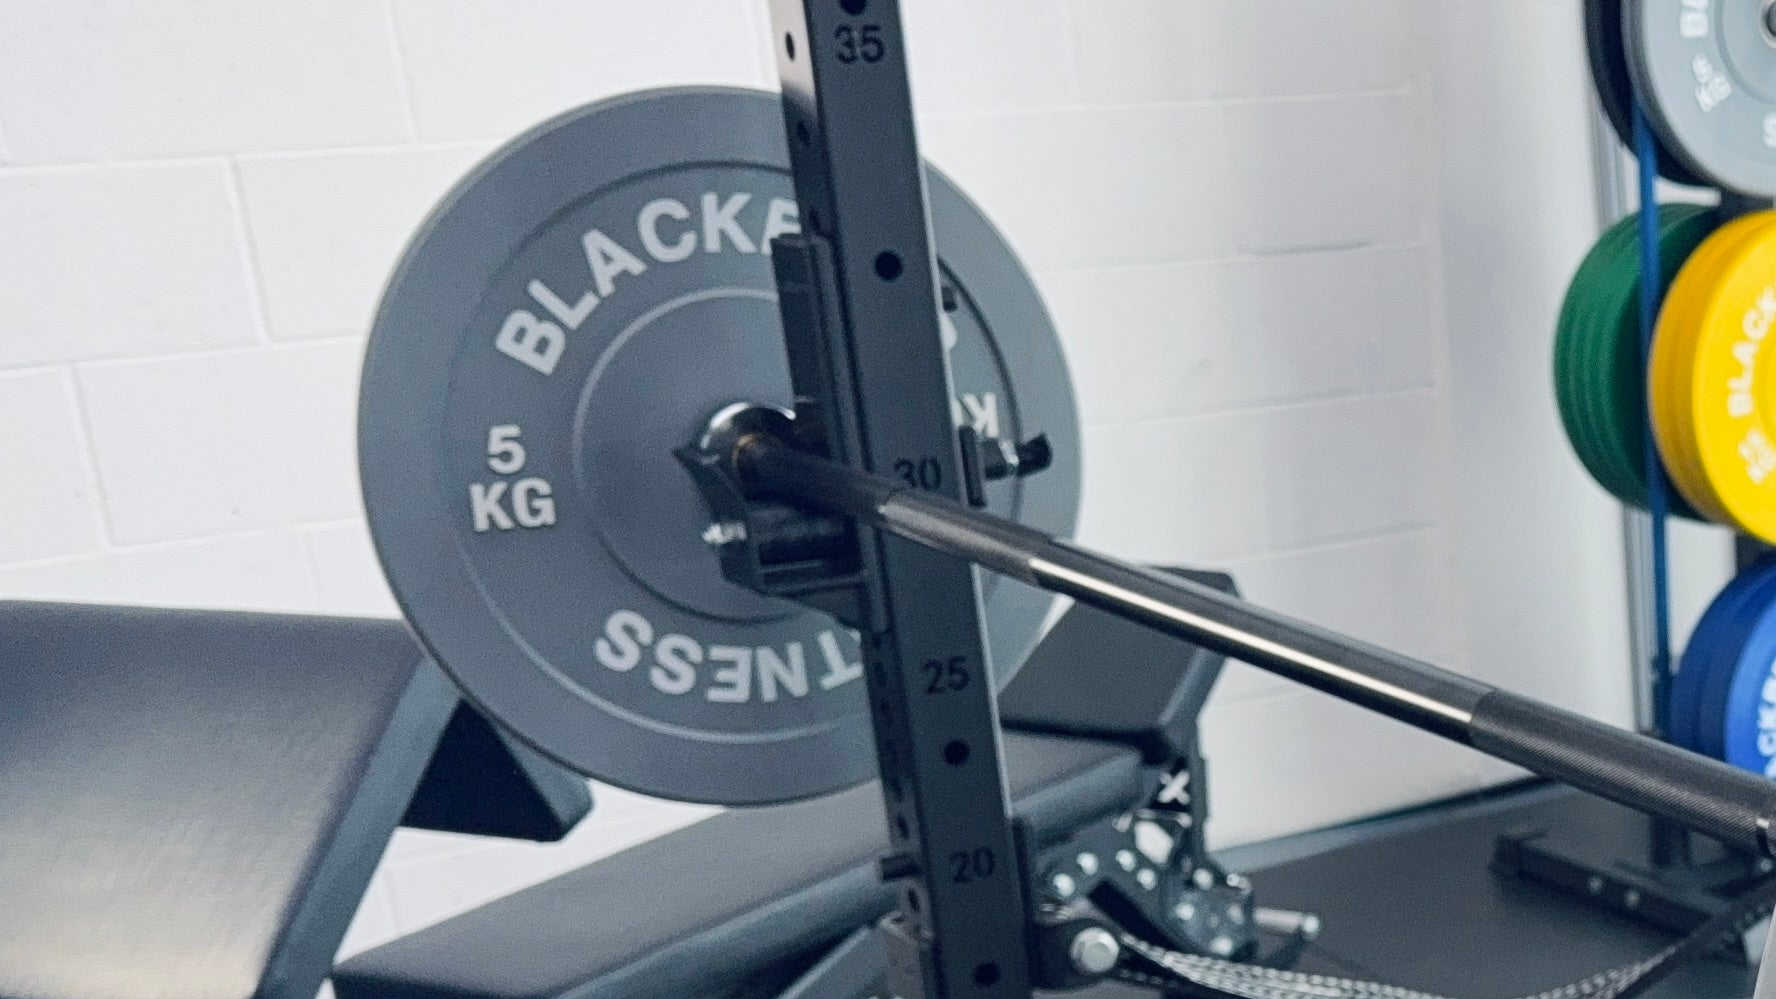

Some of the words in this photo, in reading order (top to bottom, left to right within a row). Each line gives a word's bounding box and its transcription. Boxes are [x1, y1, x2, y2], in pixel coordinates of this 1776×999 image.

[834, 24, 885, 64] 35
[487, 424, 526, 474] 5
[469, 477, 557, 533] KG
[595, 609, 863, 703] TNESS
[922, 656, 970, 694] 25
[951, 848, 996, 882] 20
